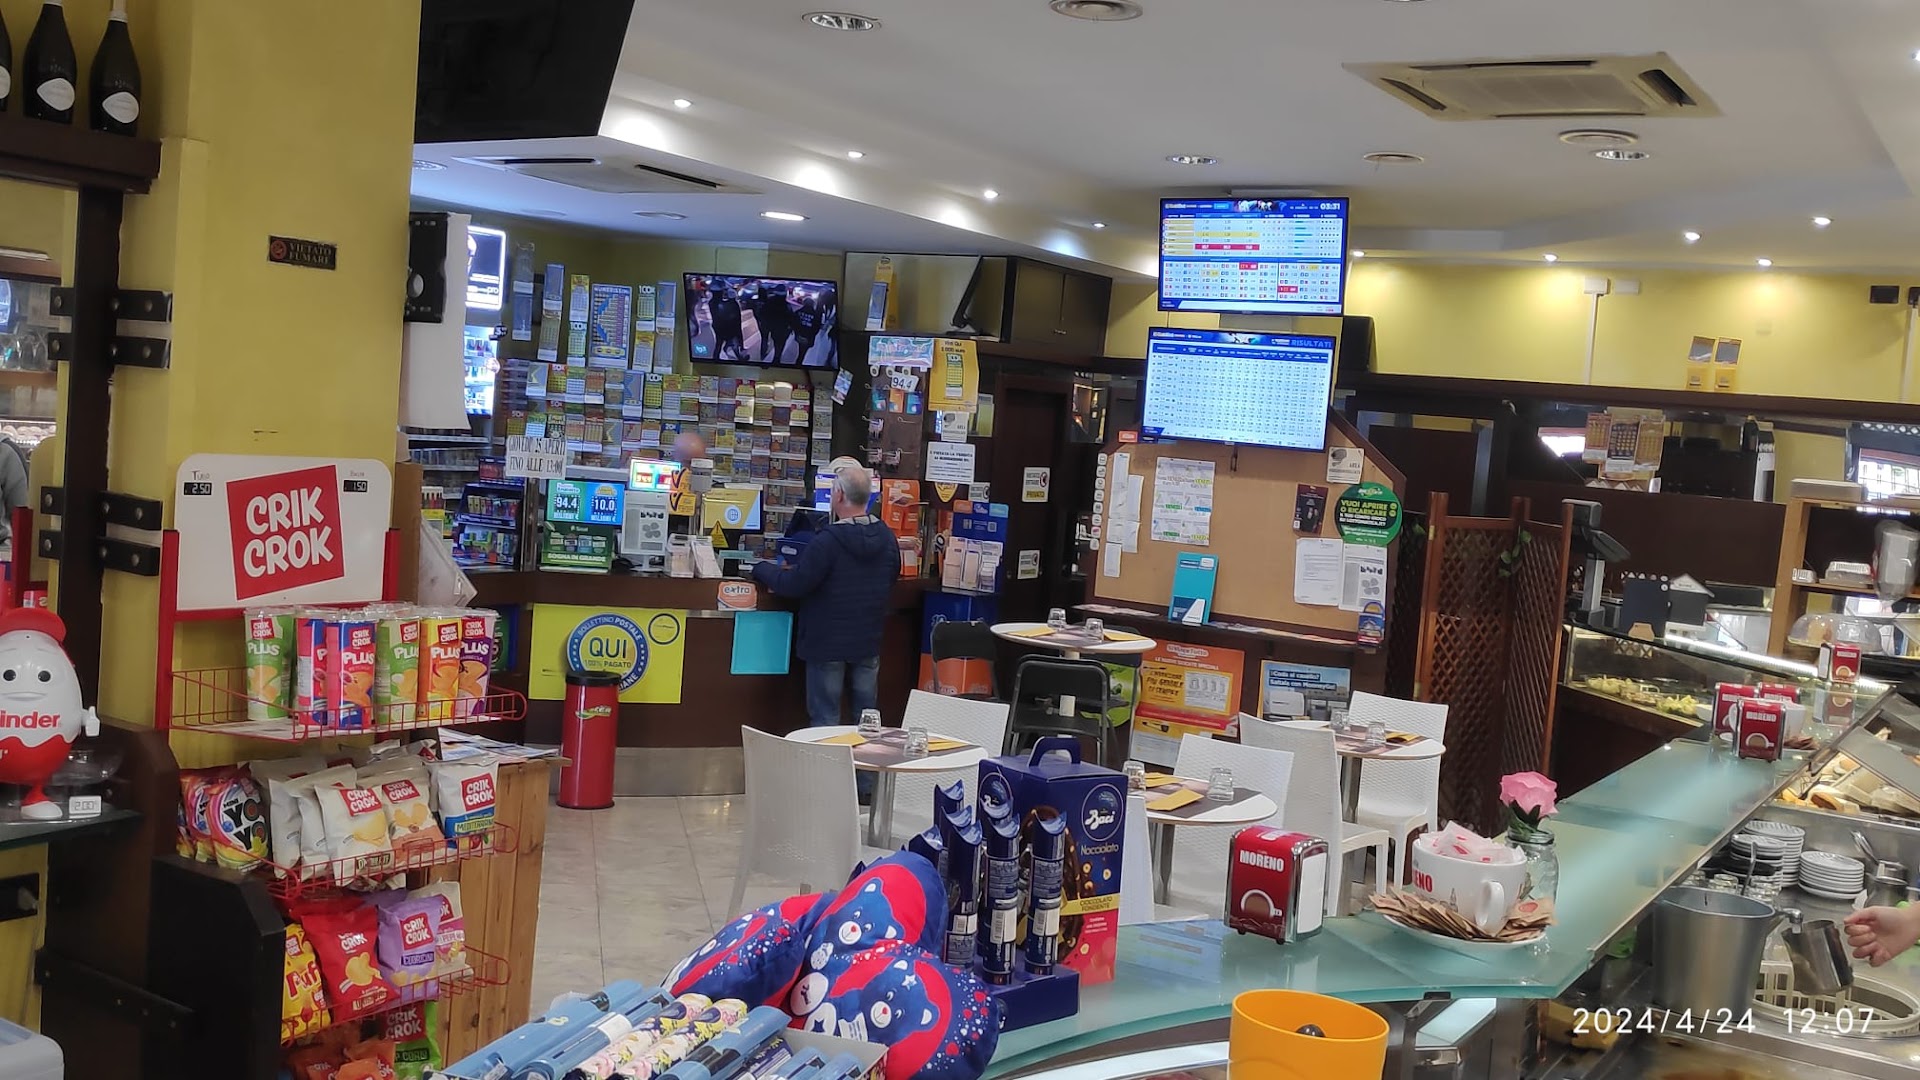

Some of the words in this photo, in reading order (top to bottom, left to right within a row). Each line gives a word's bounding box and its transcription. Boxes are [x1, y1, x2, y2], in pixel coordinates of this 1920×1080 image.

[289, 242, 332, 255] VIETATO
[289, 251, 329, 264] FUMARE
[1291, 339, 1332, 348] RISULTATI
[510, 456, 524, 470] FINO
[556, 497, 578, 509] 94.4
[594, 499, 615, 511] 10.0
[1362, 502, 1388, 510] APRIRE
[246, 486, 325, 535] CRIK
[1347, 507, 1387, 517] RICARICARE
[243, 525, 334, 578] CROK
[253, 621, 270, 630] CRIK
[441, 625, 457, 634] CRIK
[465, 621, 482, 630] CRIK
[577, 616, 614, 636] BOLLETTINO
[614, 617, 643, 640] POSTALE
[253, 629, 273, 638] CROK
[352, 629, 370, 639] CRIK
[465, 628, 485, 638] CROK
[247, 642, 280, 656] PLUS
[352, 637, 371, 647] CROK
[589, 636, 627, 659] QUI
[342, 651, 375, 665] PLUS
[389, 785, 416, 800] CROK
[467, 779, 490, 795] CRIK
[465, 789, 494, 806] CROK
[350, 798, 380, 813] CROK
[1084, 809, 1116, 830] Baci
[1081, 842, 1119, 856] Nocciolato
[1239, 849, 1284, 872] MORENO
[403, 918, 425, 933] CRIK
[341, 932, 368, 951] CROK
[405, 929, 431, 945] CROK
[387, 1008, 418, 1026] CRIK
[386, 1019, 422, 1040] CROK
